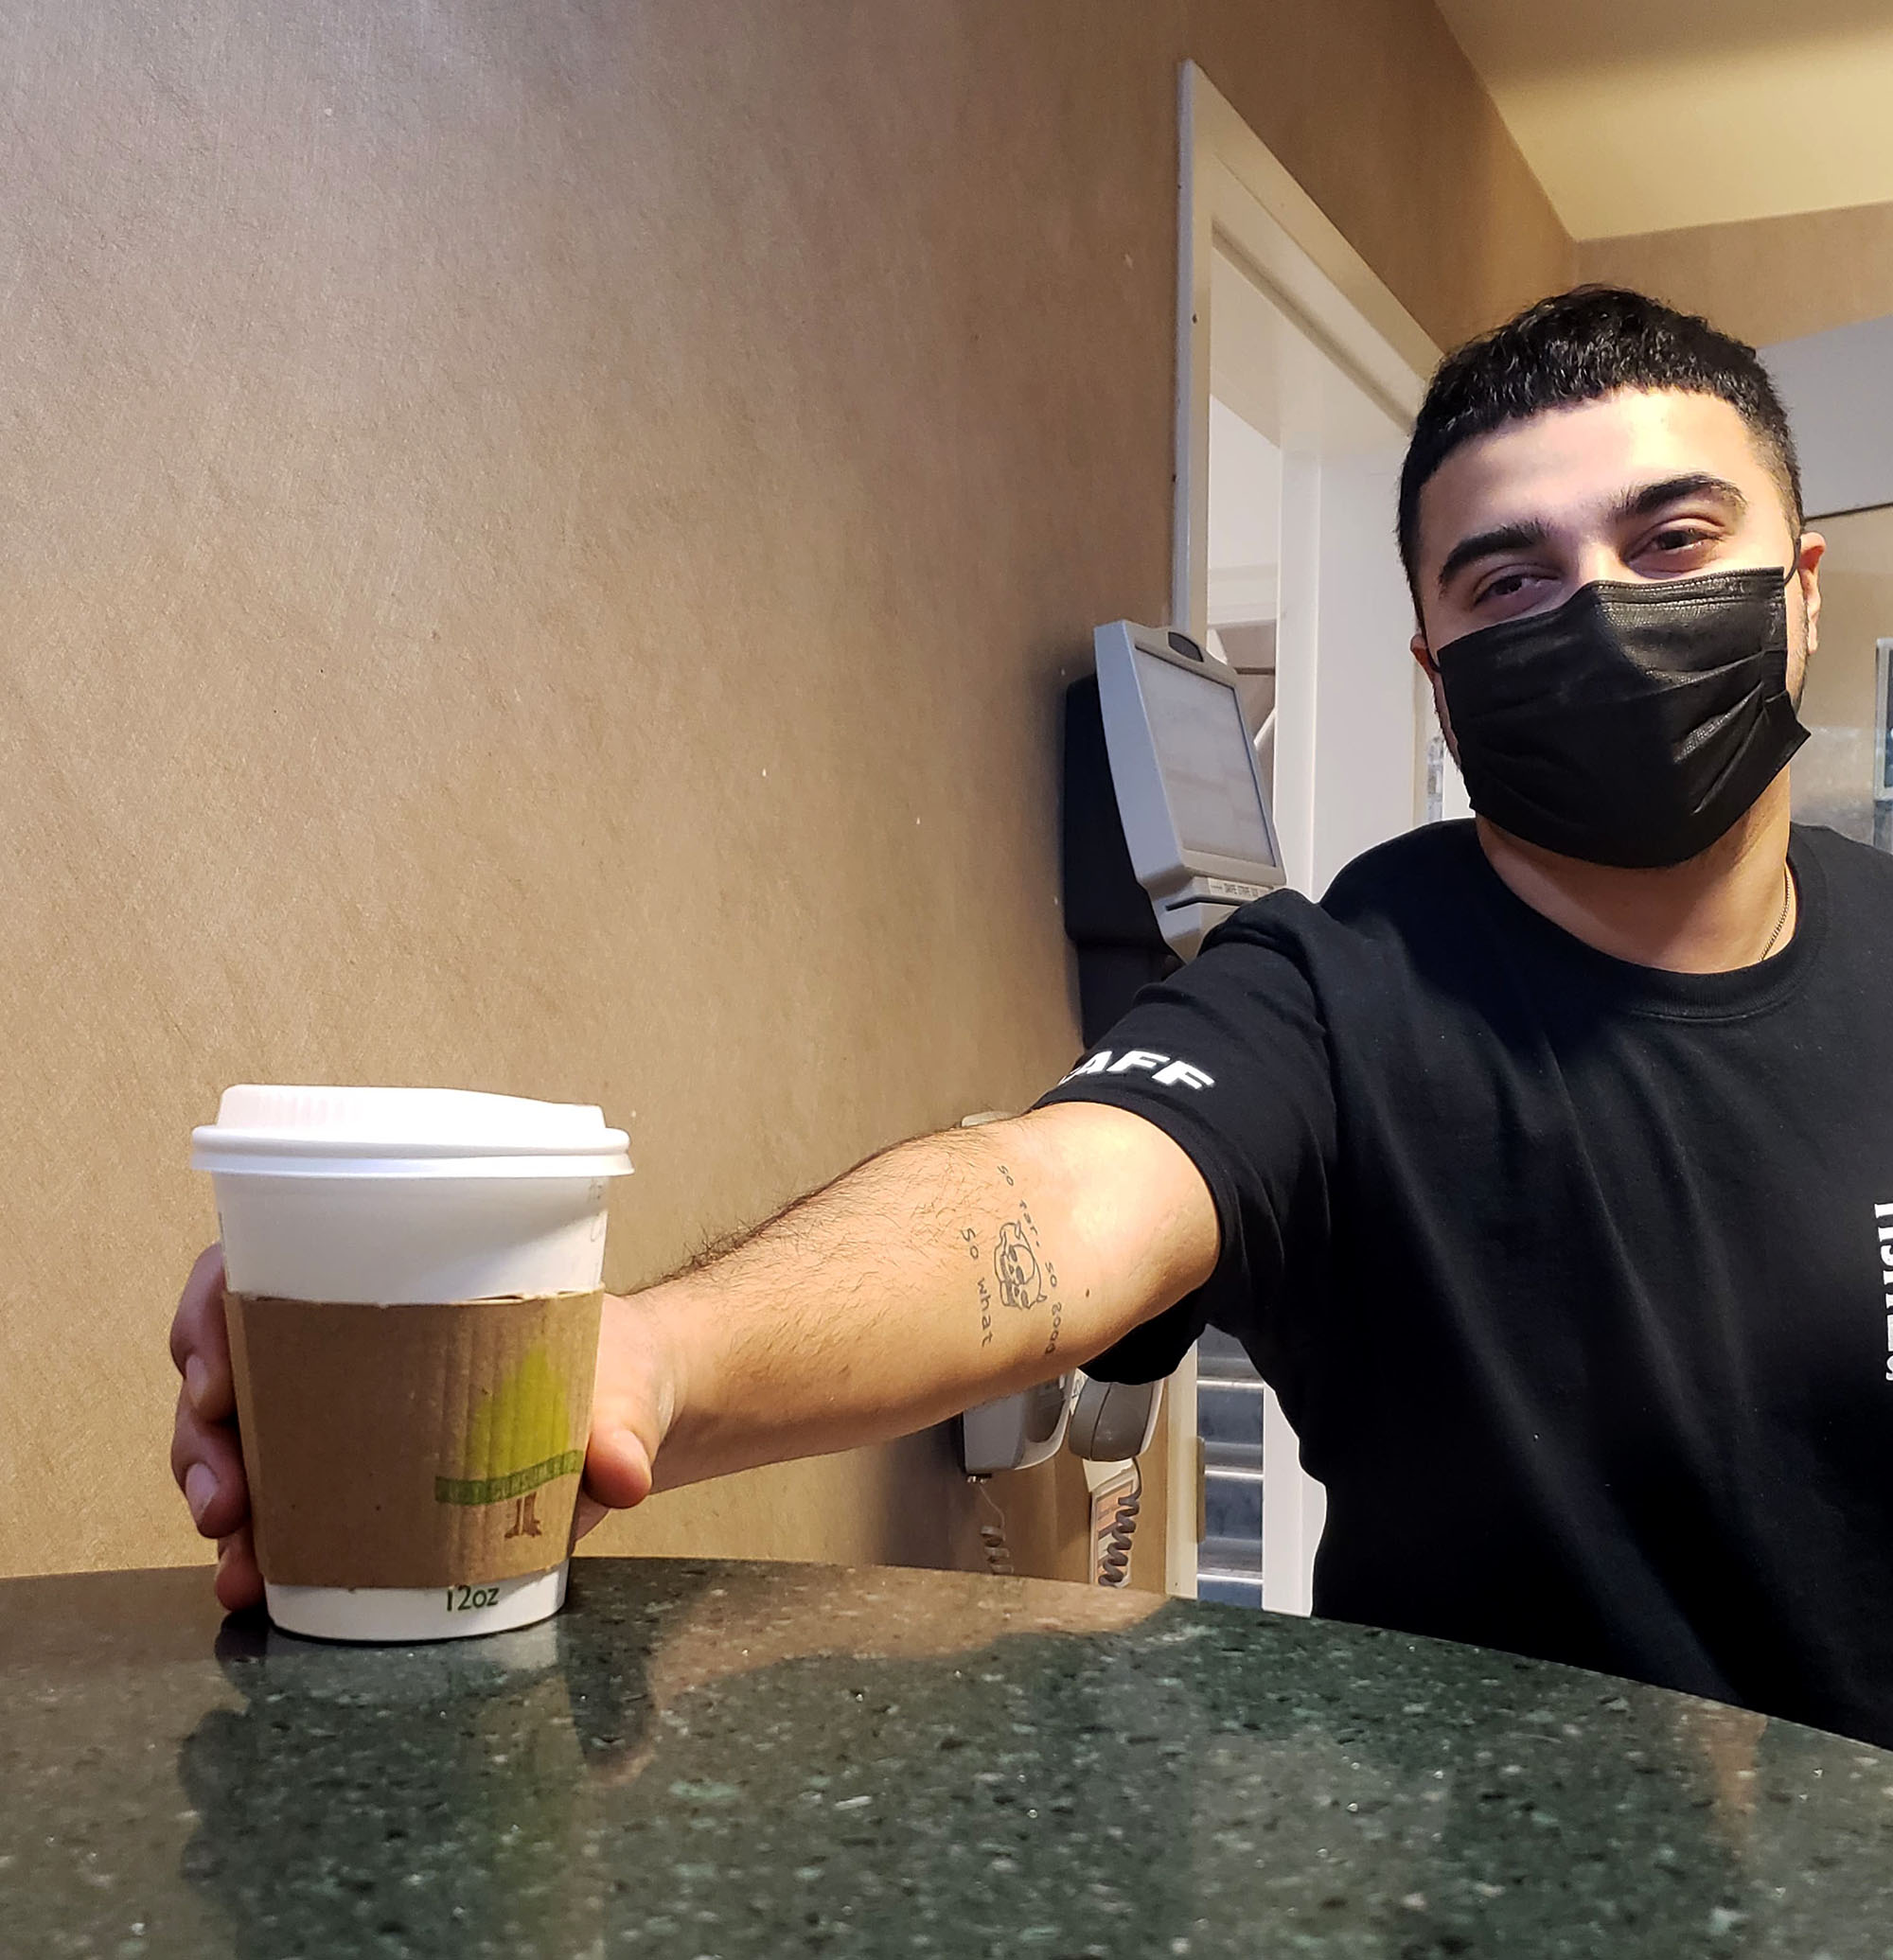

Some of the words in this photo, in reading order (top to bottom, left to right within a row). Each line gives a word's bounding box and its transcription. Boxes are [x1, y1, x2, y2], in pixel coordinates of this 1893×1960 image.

[1058, 1050, 1215, 1090] AFF
[976, 1276, 994, 1348] what
[446, 1584, 500, 1612] 12oz
